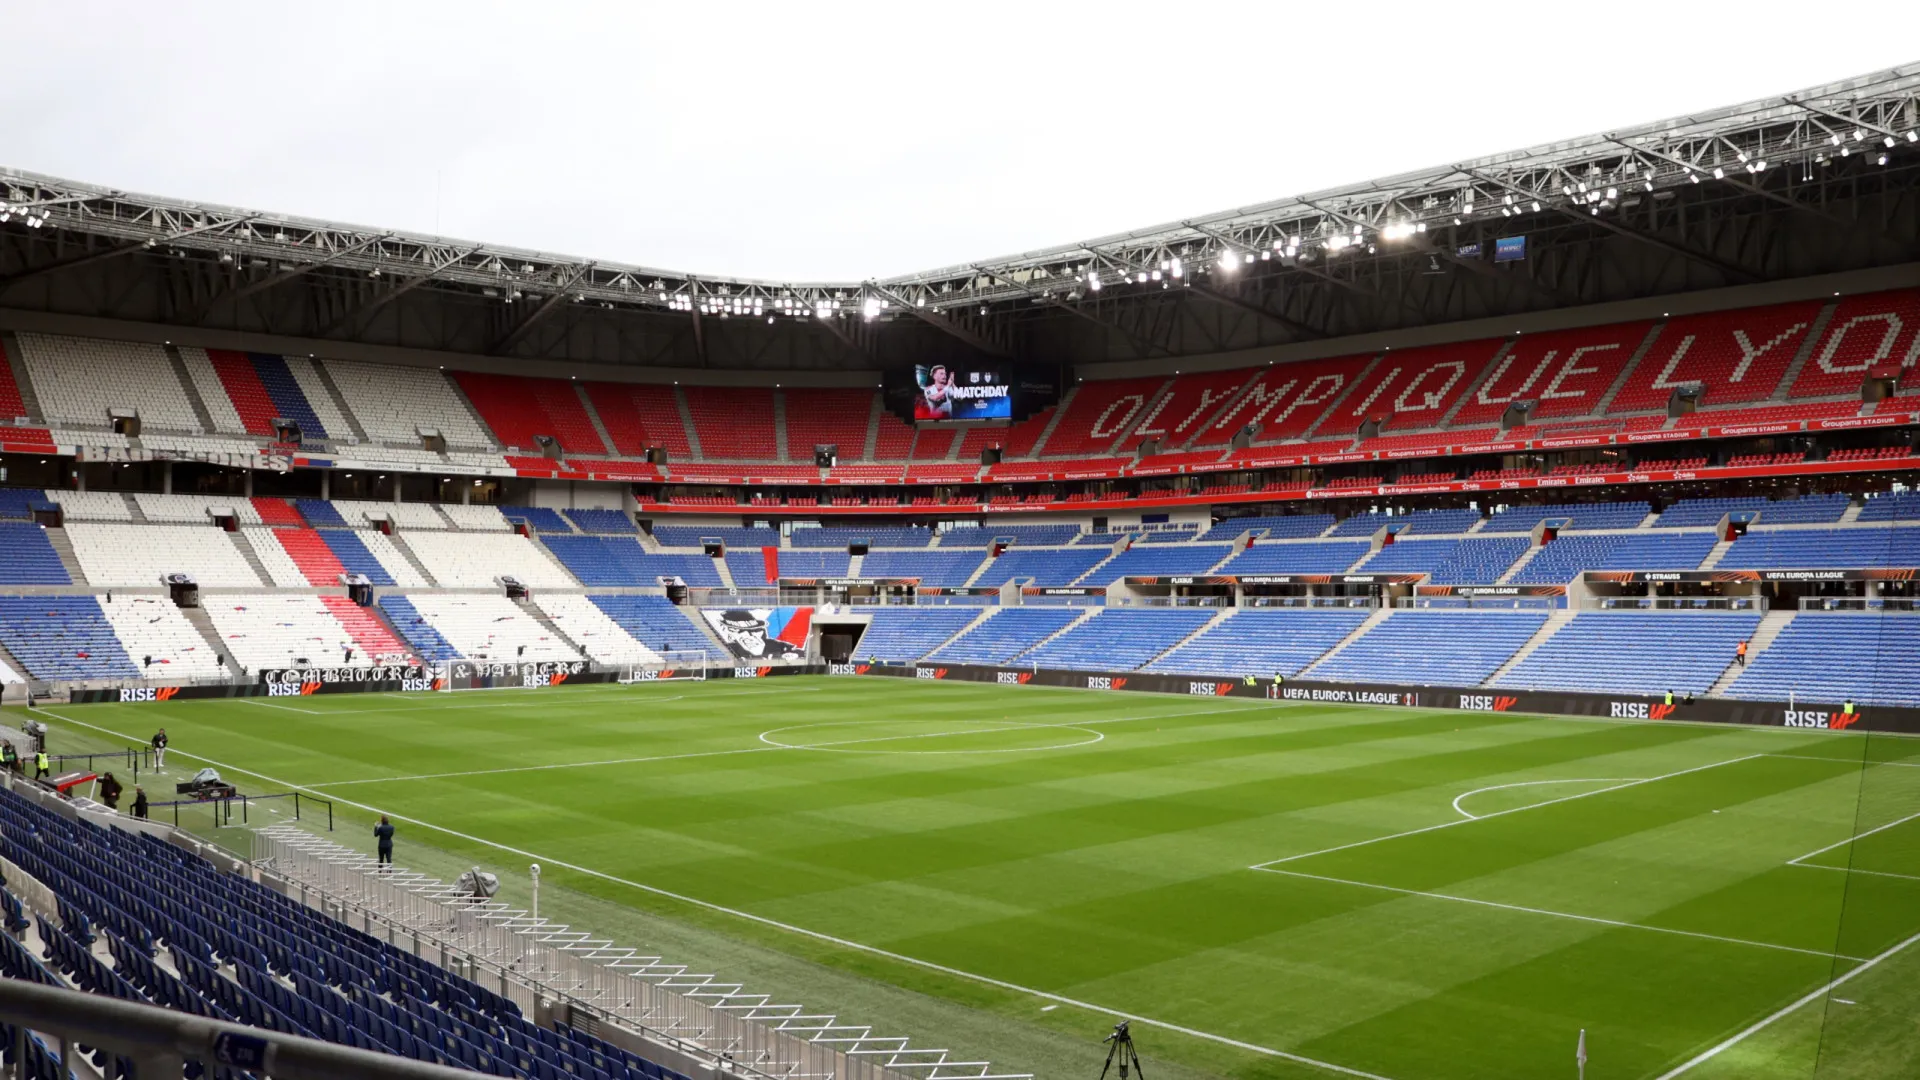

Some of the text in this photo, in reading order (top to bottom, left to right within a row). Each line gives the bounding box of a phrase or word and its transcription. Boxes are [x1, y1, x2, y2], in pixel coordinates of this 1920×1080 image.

[1460, 245, 1476, 254] UEFA
[953, 385, 1009, 399] MATCHDAY
[1091, 343, 1620, 438] OLYMPIQUE
[1721, 426, 1757, 434] Groupama
[1822, 420, 1860, 428] Groupama
[1538, 479, 1566, 487] Emirates
[1575, 476, 1605, 484] Emirates
[265, 666, 419, 684] COMBATTRE
[634, 671, 658, 680] RISE
[735, 667, 756, 678] RISE
[832, 664, 855, 675] RISE
[917, 667, 935, 678] RISE
[524, 675, 550, 687] RISE
[998, 672, 1018, 684] RISE
[1088, 677, 1111, 688] RISE
[268, 683, 300, 696] RISE
[402, 678, 431, 691] RISE
[1190, 682, 1215, 695] RISE
[120, 688, 157, 702] RISE
[1283, 688, 1398, 704] UEFA EUROPA LEAGUE
[1460, 695, 1492, 711] RISE
[1610, 702, 1648, 719] RISE
[1784, 710, 1829, 729] RISE
